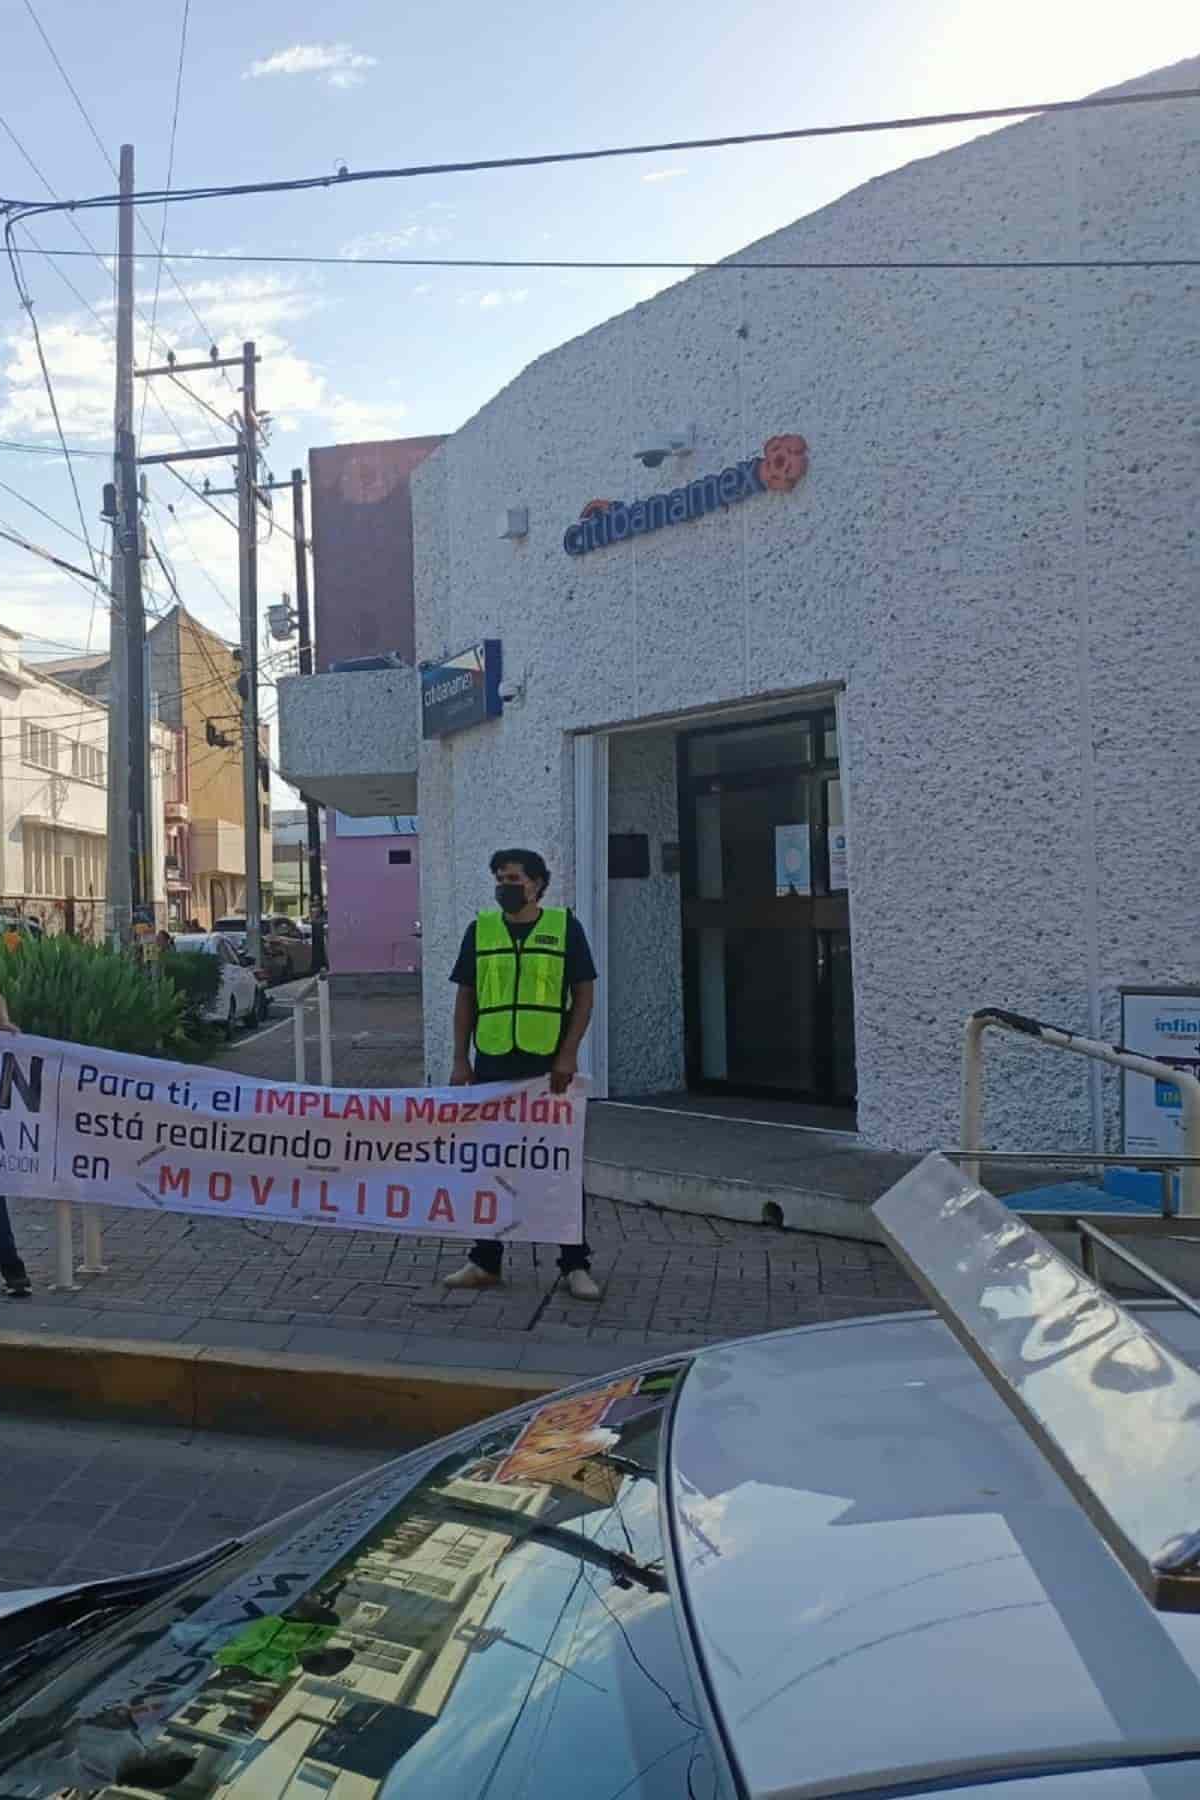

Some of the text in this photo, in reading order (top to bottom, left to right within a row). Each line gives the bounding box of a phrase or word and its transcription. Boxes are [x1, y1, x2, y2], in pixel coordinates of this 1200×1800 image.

[77, 1064, 573, 1125] Para ti, el IMPLAN Mazatlán
[75, 1111, 570, 1173] está realizando investigación
[71, 1154, 498, 1225] en MOVILIDAD
